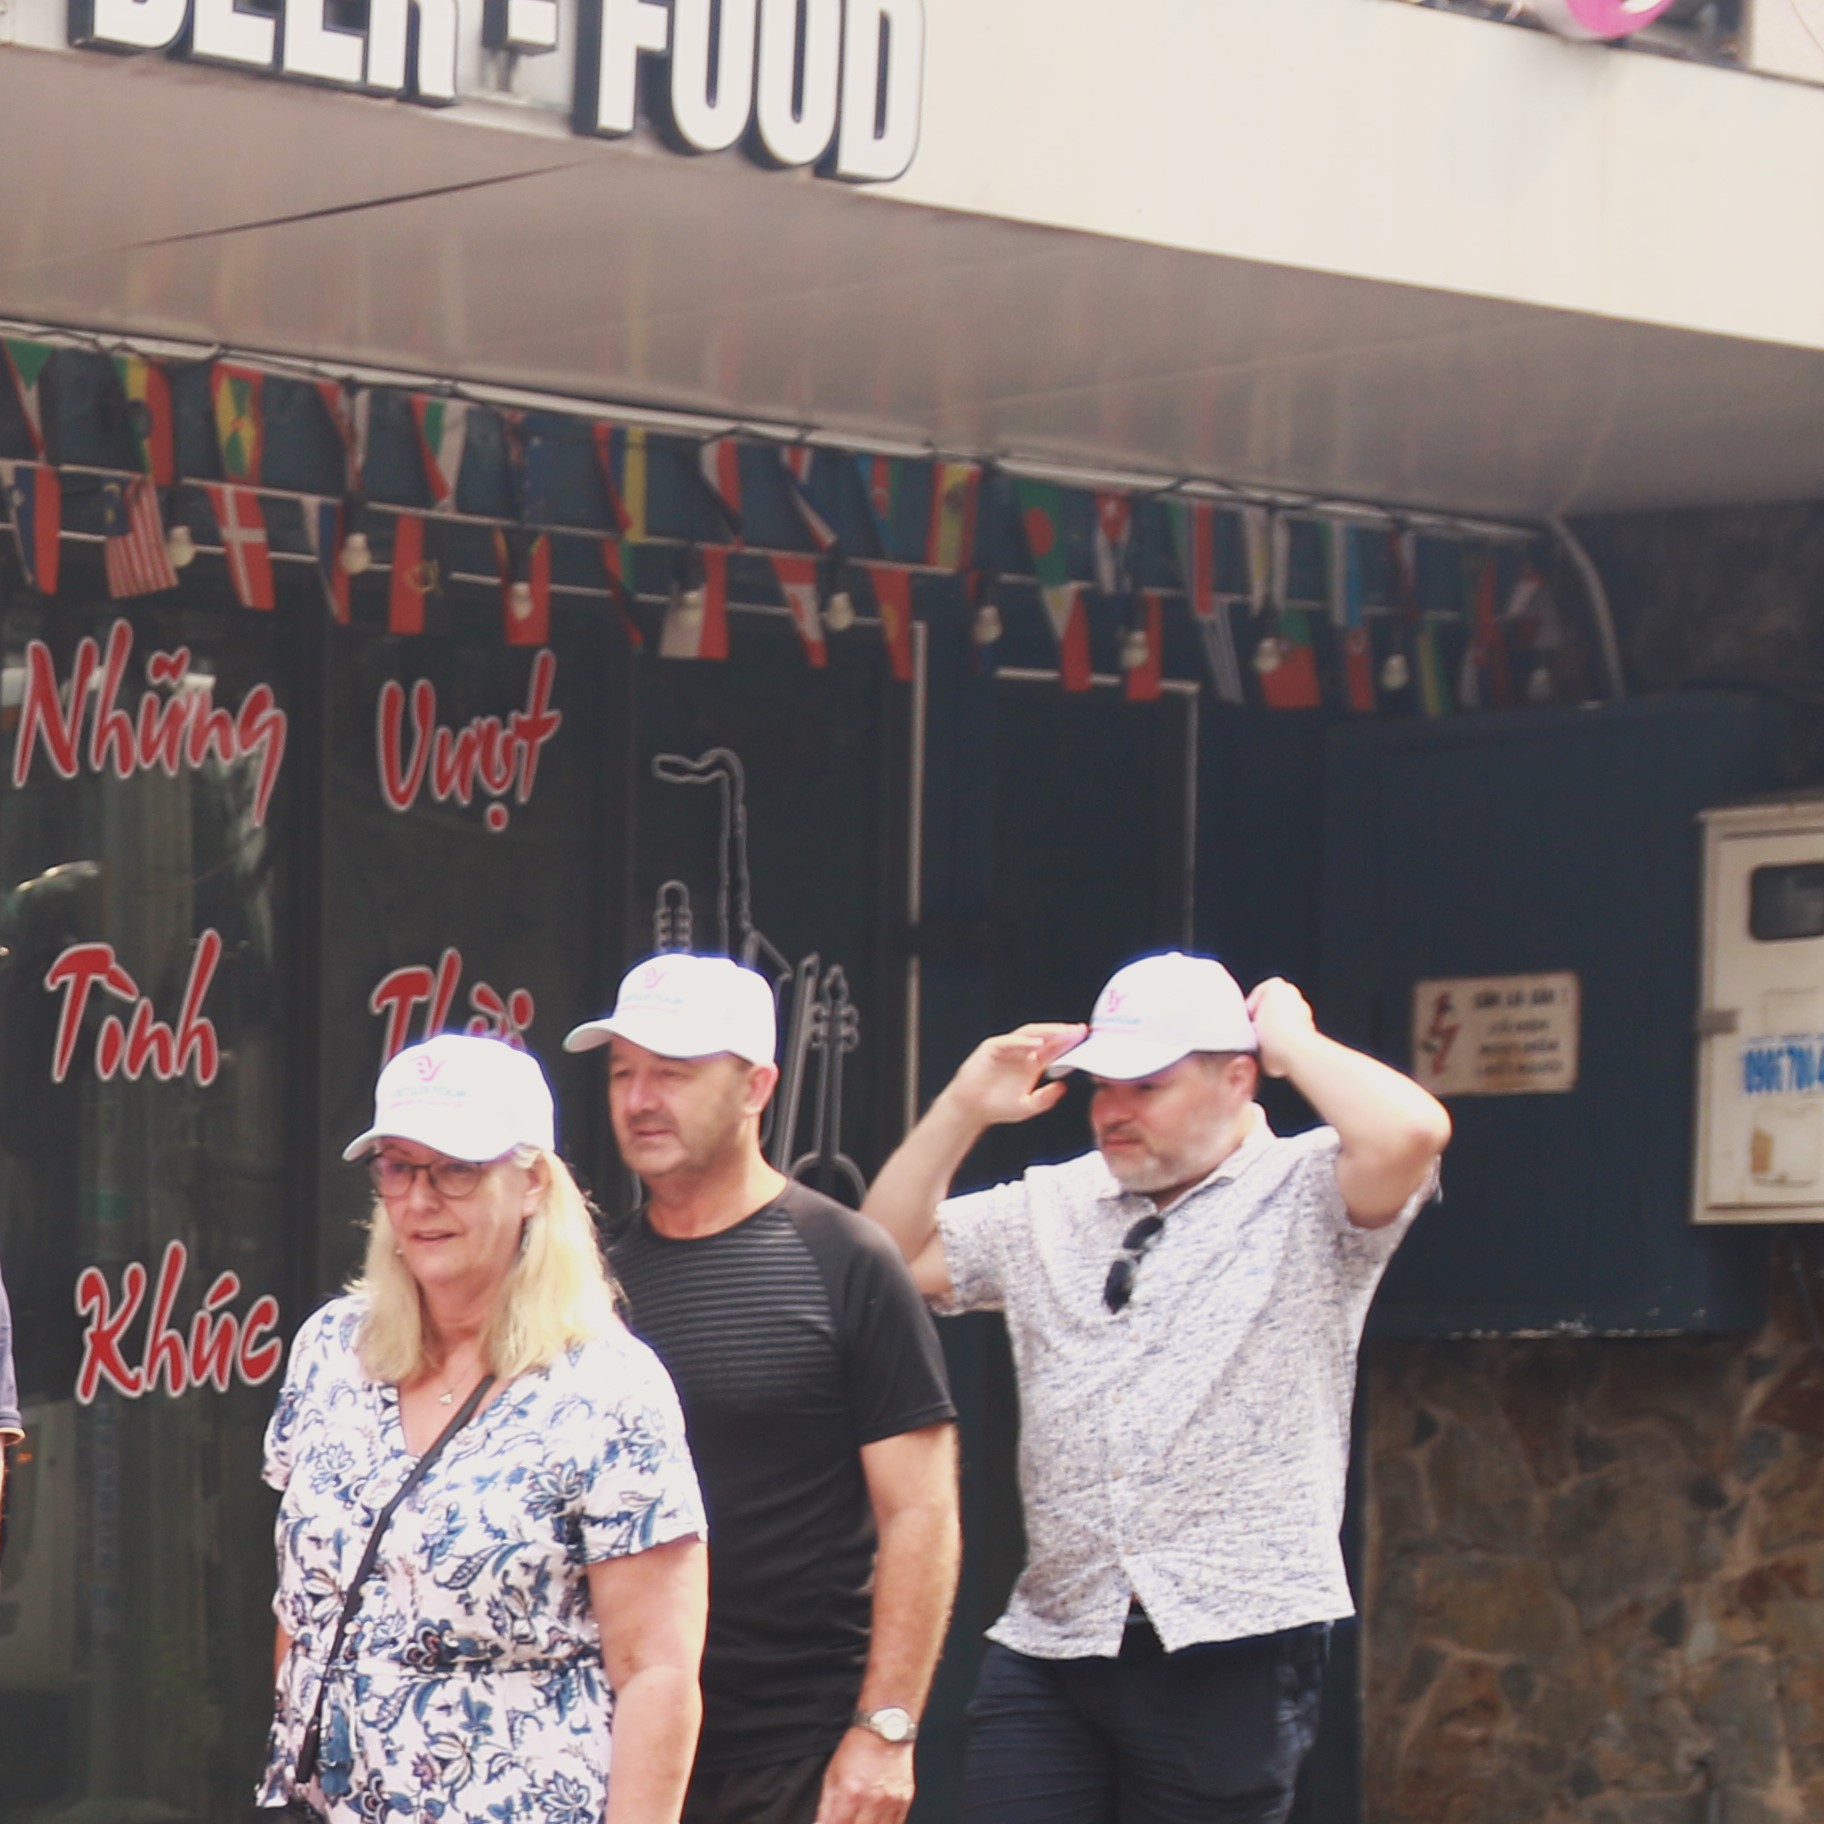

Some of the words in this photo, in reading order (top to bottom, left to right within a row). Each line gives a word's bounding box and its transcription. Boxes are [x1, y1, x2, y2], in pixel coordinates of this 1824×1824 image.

[577, 0, 925, 183] FOOD
[12, 617, 288, 827] Những
[376, 648, 562, 831] Vượt
[45, 927, 222, 1087] Tình
[75, 1238, 283, 1404] Khúc
